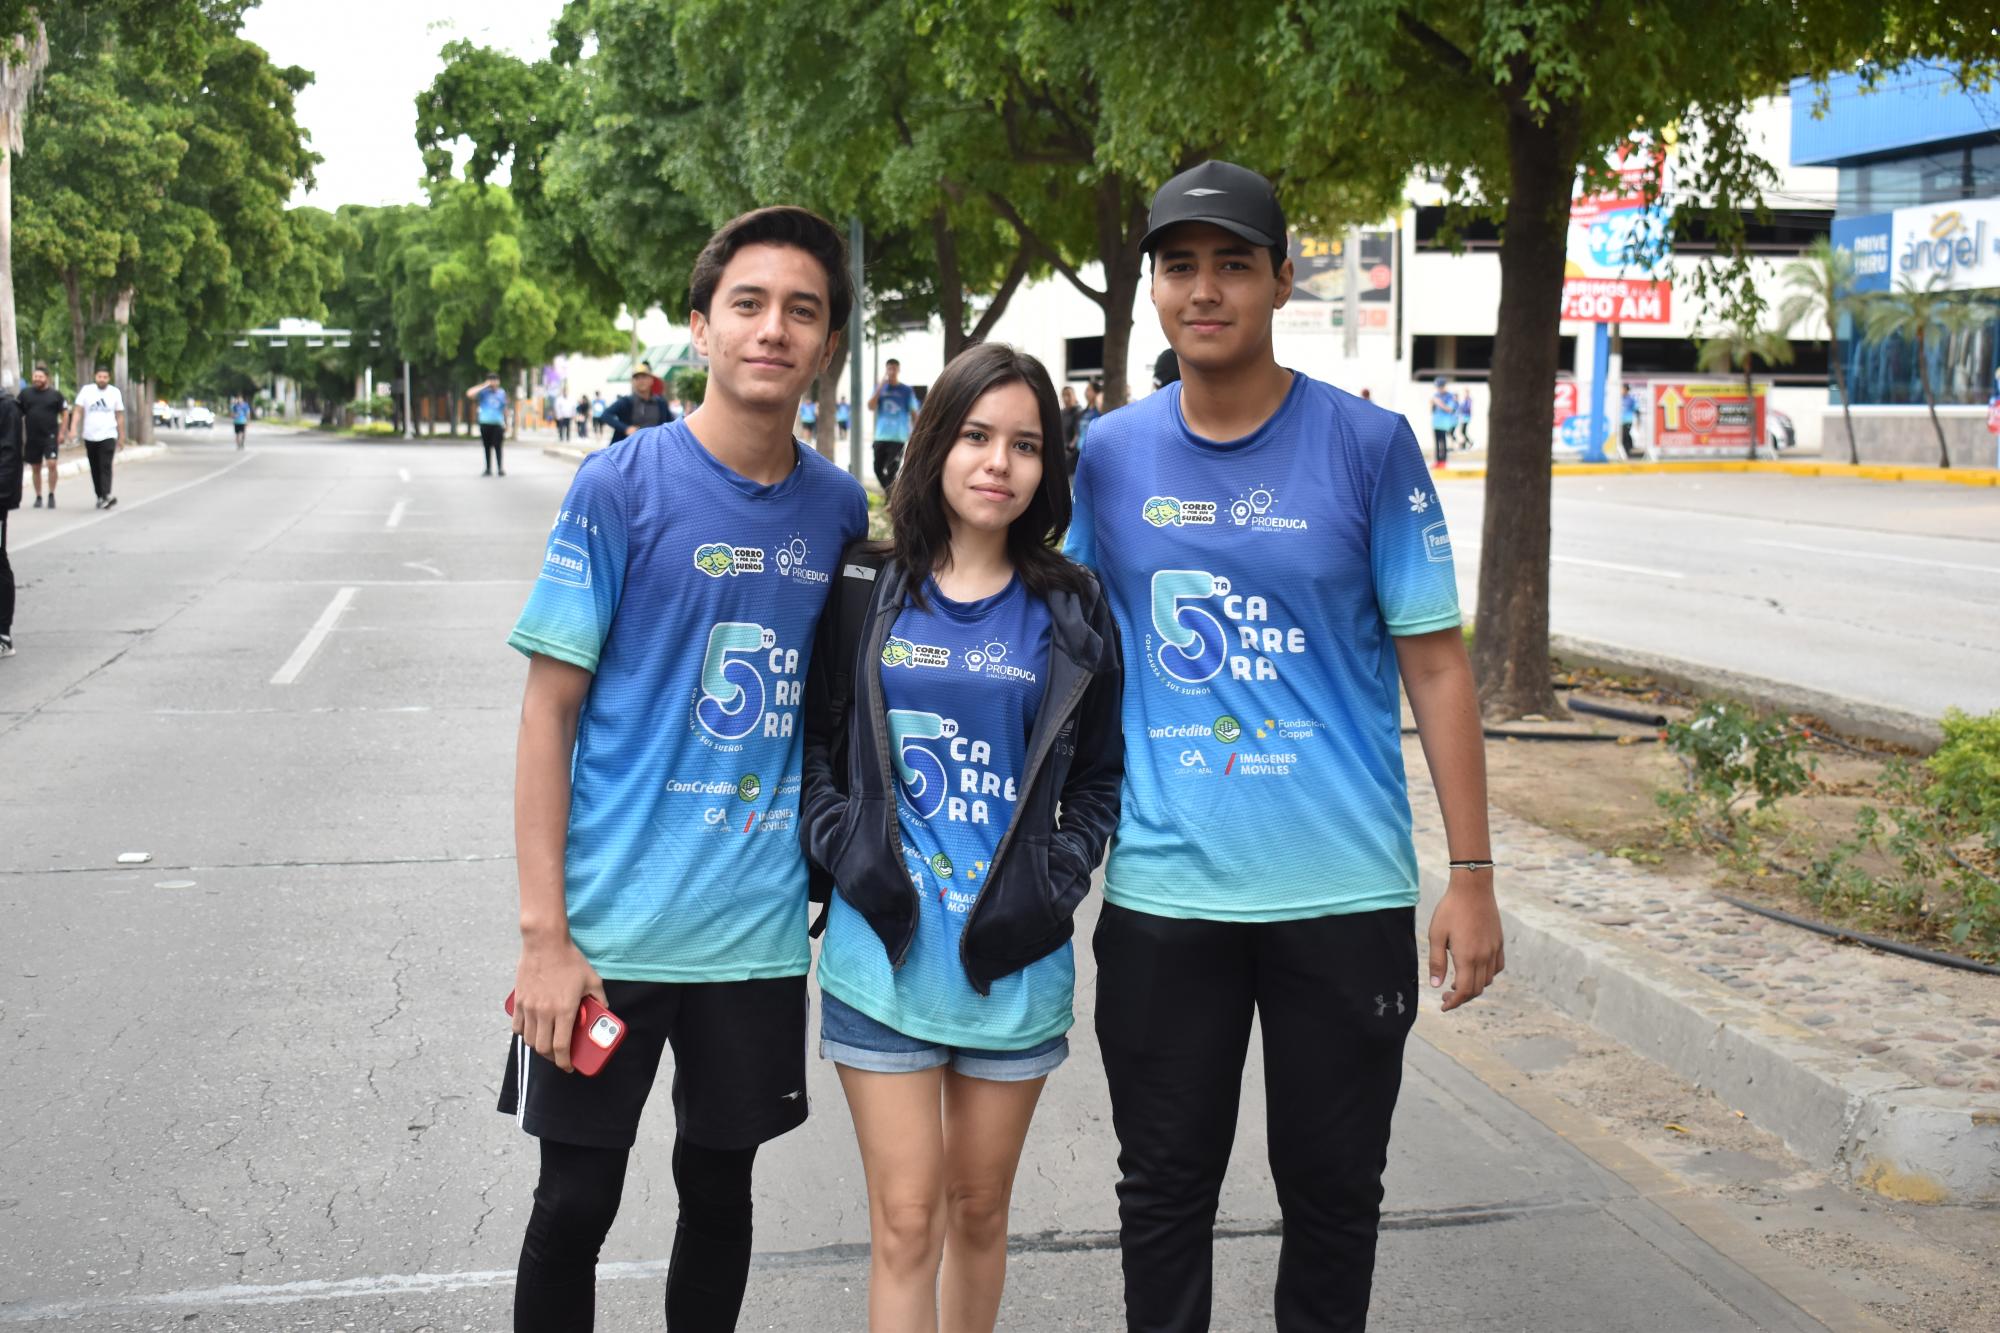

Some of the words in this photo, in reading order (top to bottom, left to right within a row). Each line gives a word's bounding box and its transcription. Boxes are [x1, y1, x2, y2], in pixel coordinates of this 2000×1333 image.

[1854, 234, 1888, 251] DRIVE
[1854, 253, 1888, 275] THRU
[1619, 297, 1662, 319] AM
[1182, 503, 1215, 511] CORRO
[1251, 516, 1308, 530] PROEDUCA
[735, 549, 763, 558] CORRO
[792, 567, 829, 584] PROEDUCA
[1223, 595, 1268, 621] CA
[1238, 626, 1305, 653] RRE
[768, 647, 799, 674] CA
[915, 646, 948, 656] CORRO
[913, 657, 946, 666] SUEÑOS
[1229, 655, 1278, 681] RA
[986, 663, 1036, 684] PROEDUCA
[775, 680, 807, 706] RR
[763, 712, 794, 737] RA
[1279, 729, 1314, 740] Coppel
[950, 737, 991, 766] CA
[1180, 750, 1207, 767] GA
[666, 779, 738, 795] ConCrédito
[703, 807, 727, 825] GA
[948, 797, 990, 825] RA
